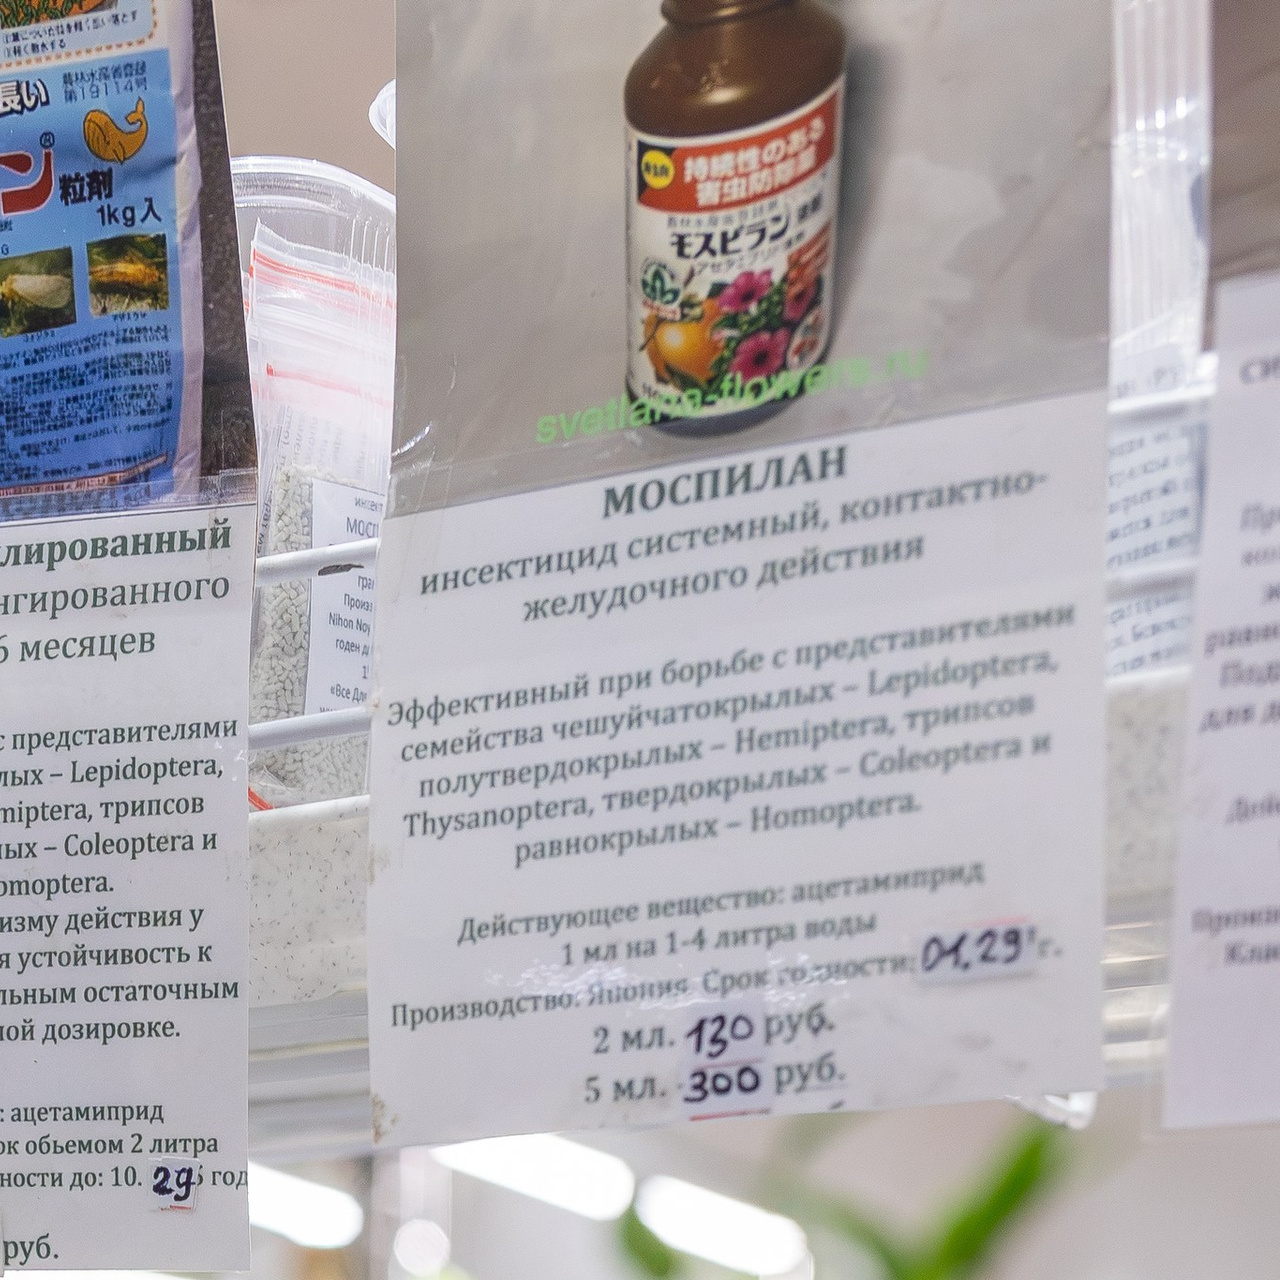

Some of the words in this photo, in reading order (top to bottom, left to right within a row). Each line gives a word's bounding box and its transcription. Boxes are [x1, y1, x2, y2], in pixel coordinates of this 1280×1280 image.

[59, 166, 115, 205] 粒剤
[603, 445, 846, 519] МОСПИЛАН
[19, 631, 155, 662] месяцев
[12, 719, 237, 756] представителями
[17, 943, 191, 975] устойчивость
[198, 945, 212, 962] к
[41, 1020, 180, 1046] дозировке.
[686, 1014, 754, 1059] 130
[683, 1065, 761, 1104] 300
[69, 1171, 103, 1191] до:
[111, 1165, 142, 1187] 10.
